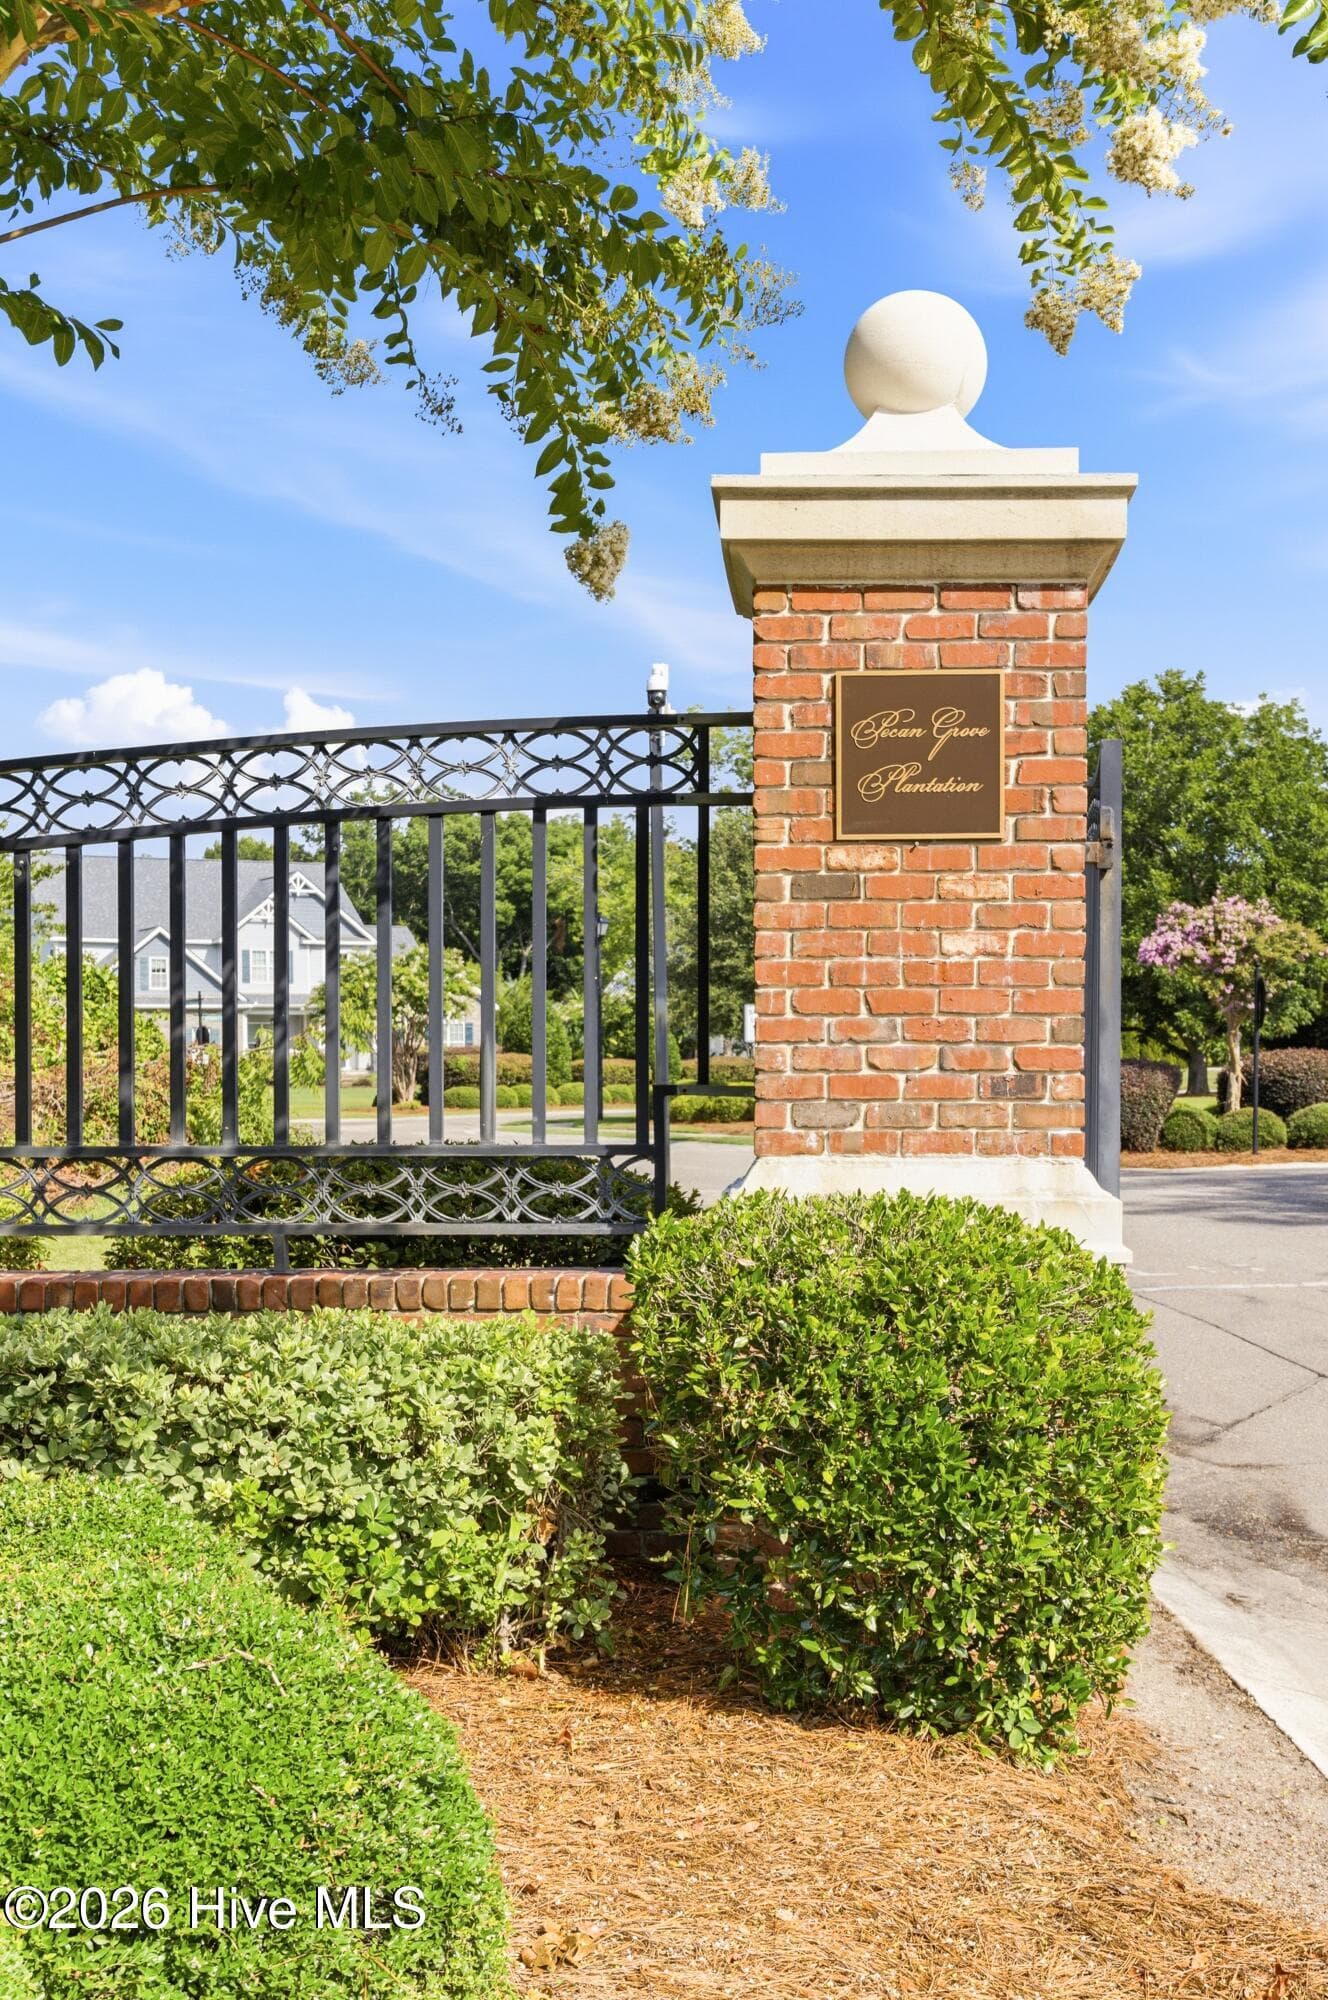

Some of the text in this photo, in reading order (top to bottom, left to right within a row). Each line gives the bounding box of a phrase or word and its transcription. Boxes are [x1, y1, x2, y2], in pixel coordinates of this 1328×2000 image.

[850, 706, 990, 761] Pecan Grove
[857, 762, 984, 802] Plantation
